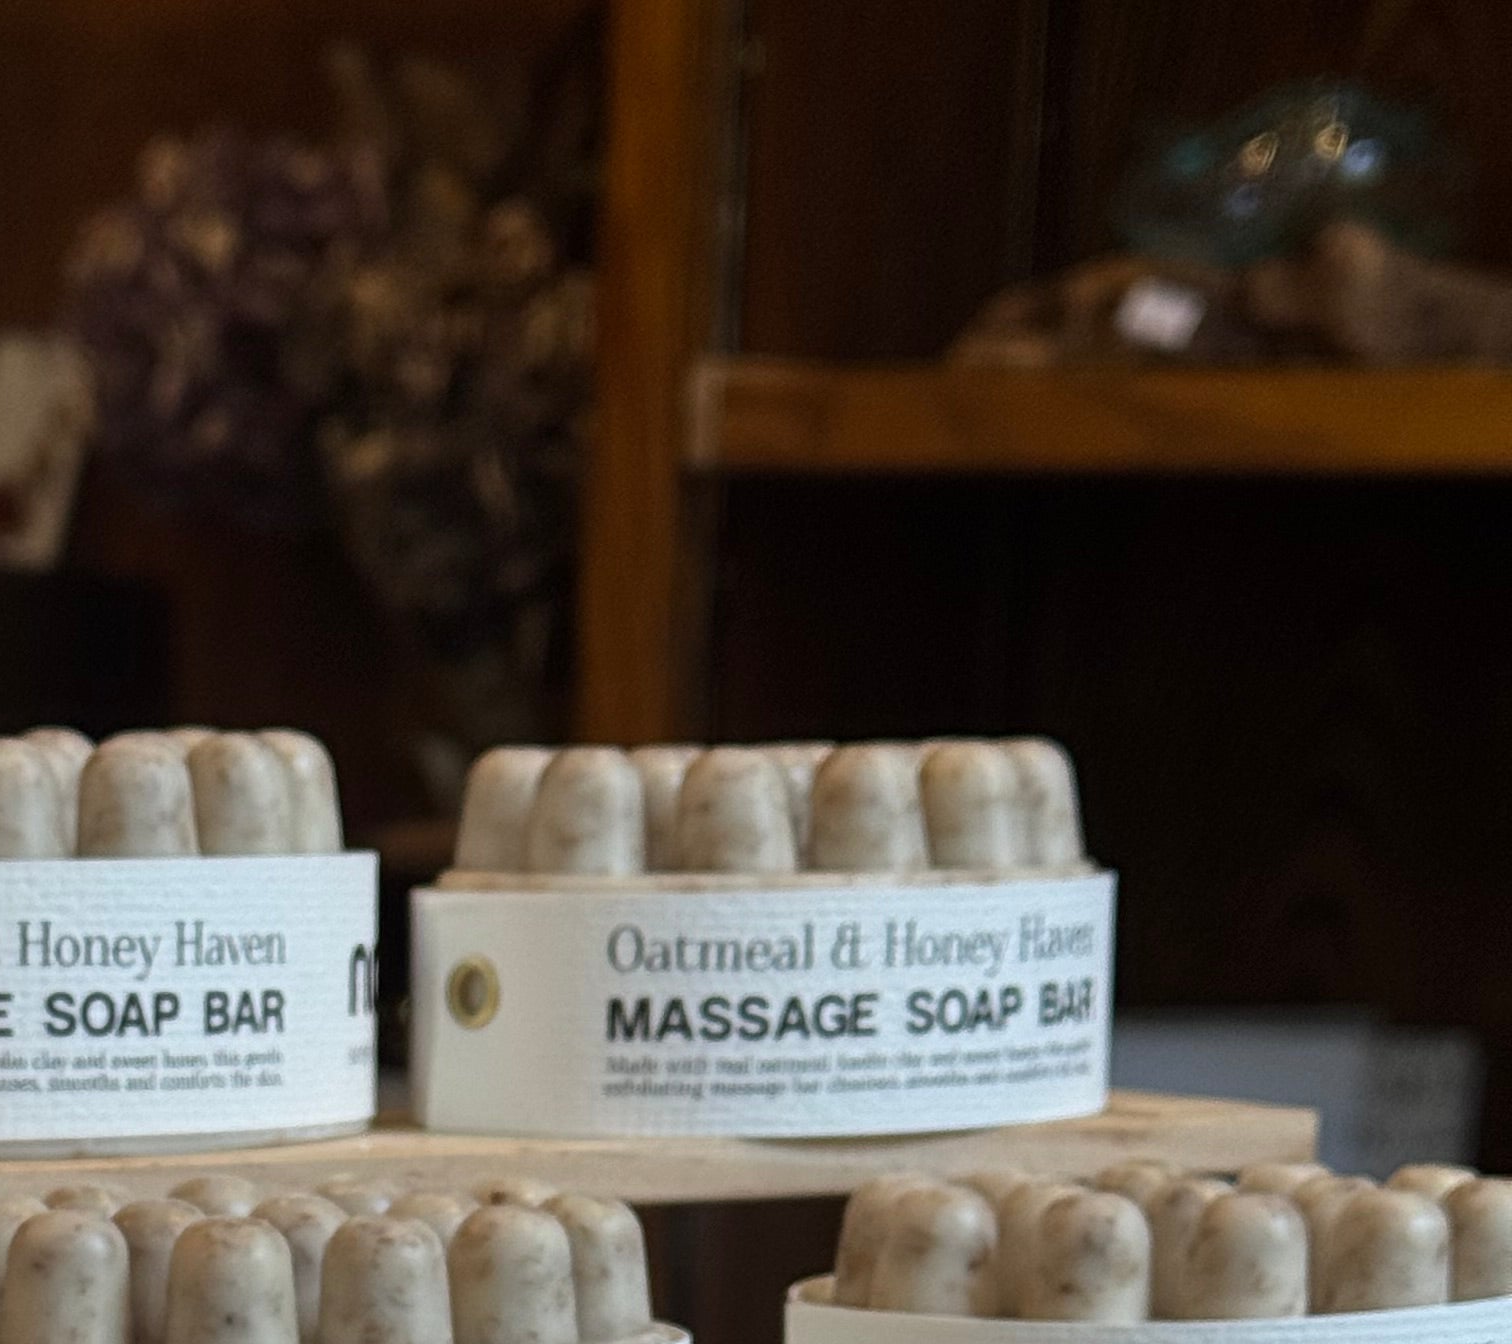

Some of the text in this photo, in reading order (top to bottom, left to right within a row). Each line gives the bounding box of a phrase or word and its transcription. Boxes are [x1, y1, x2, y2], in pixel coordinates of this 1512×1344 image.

[17, 919, 160, 978] Honey
[174, 919, 287, 968] Haven
[606, 922, 815, 974] Oatmeal
[830, 924, 869, 970] &
[885, 922, 1008, 978] Honey
[44, 991, 180, 1037] SOAP
[203, 990, 285, 1035] BAR
[606, 982, 1093, 1043] MASSAGE SOAP BAR
